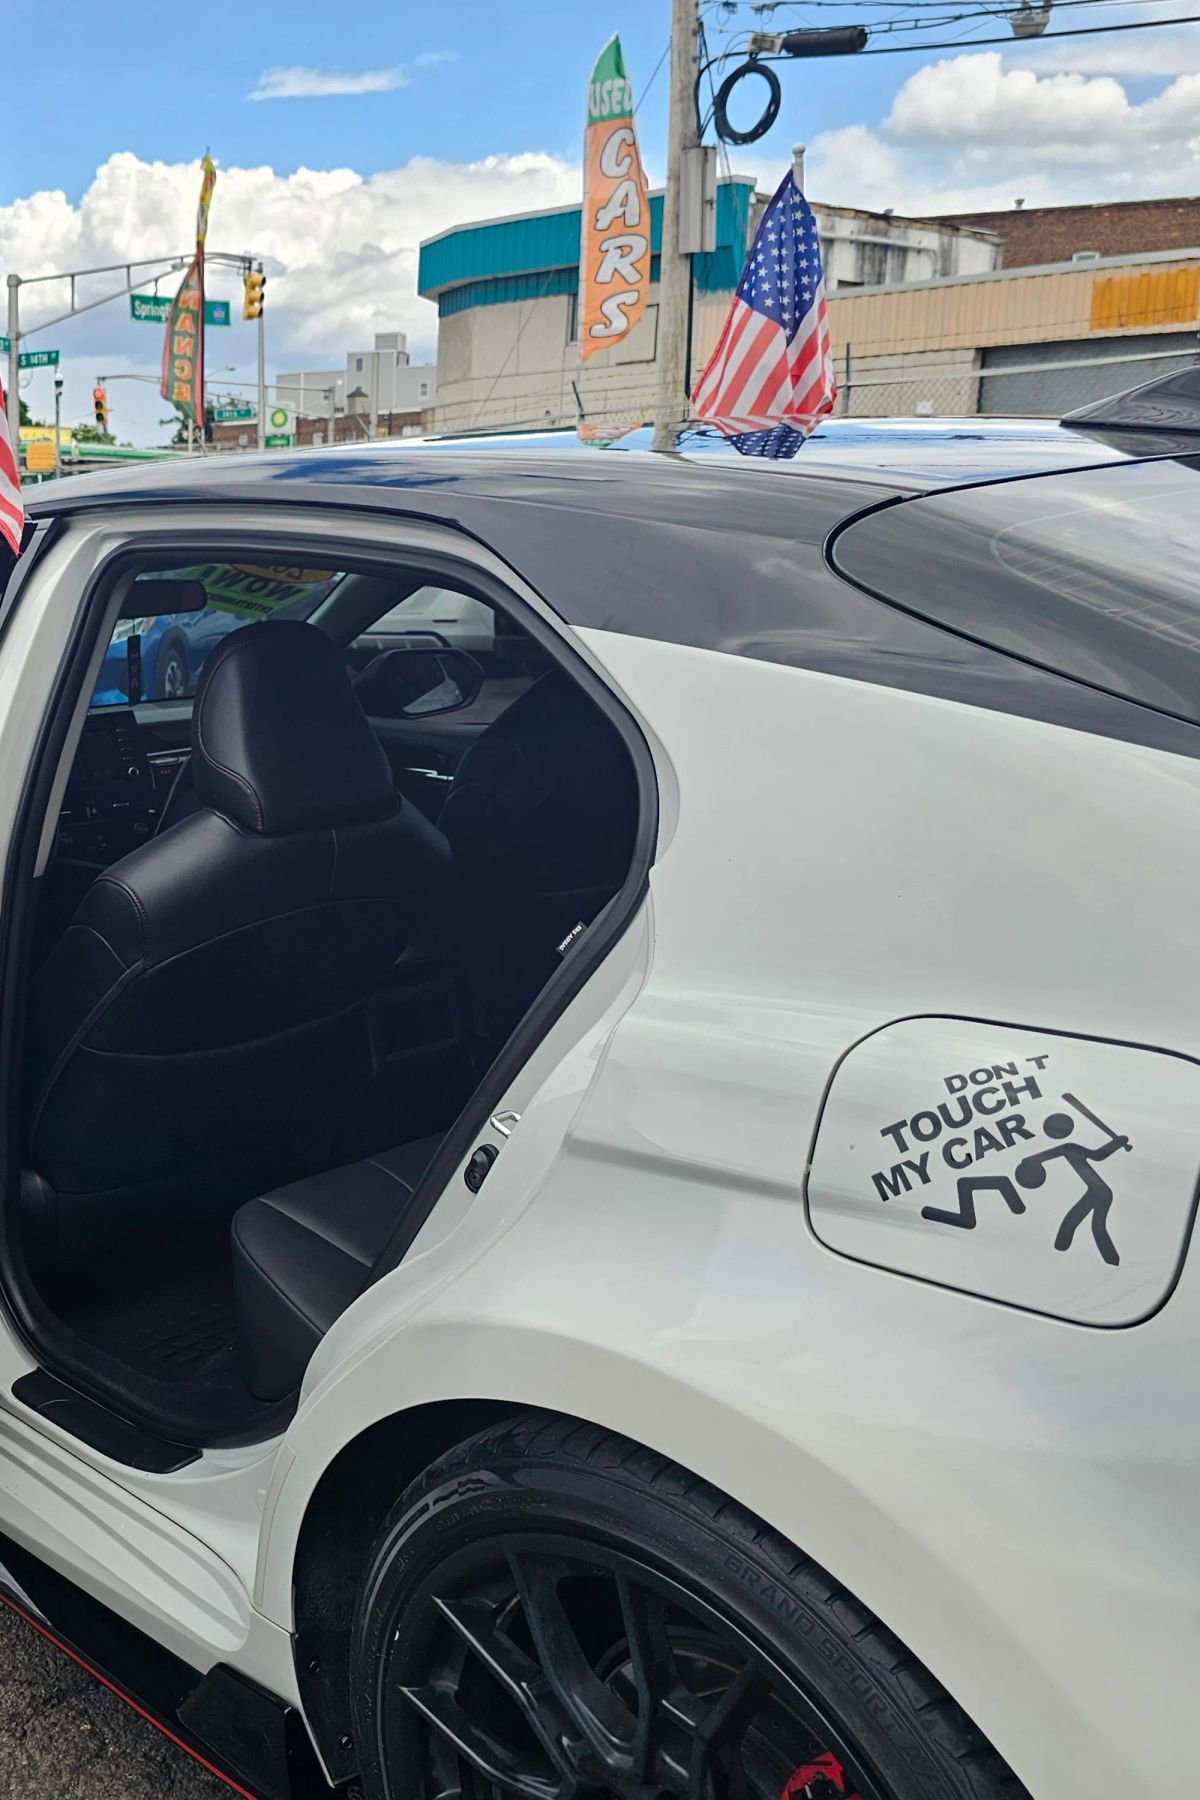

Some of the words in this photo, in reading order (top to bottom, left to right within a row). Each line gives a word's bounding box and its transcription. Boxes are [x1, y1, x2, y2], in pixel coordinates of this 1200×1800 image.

[589, 78, 633, 118] USED
[589, 126, 648, 339] CARS
[871, 1151, 932, 1202] MY
[942, 1113, 1036, 1170] CAR
[880, 1075, 1043, 1154] TOUCH
[723, 1554, 816, 1637] GRAND
[816, 1639, 906, 1732] SPORT
